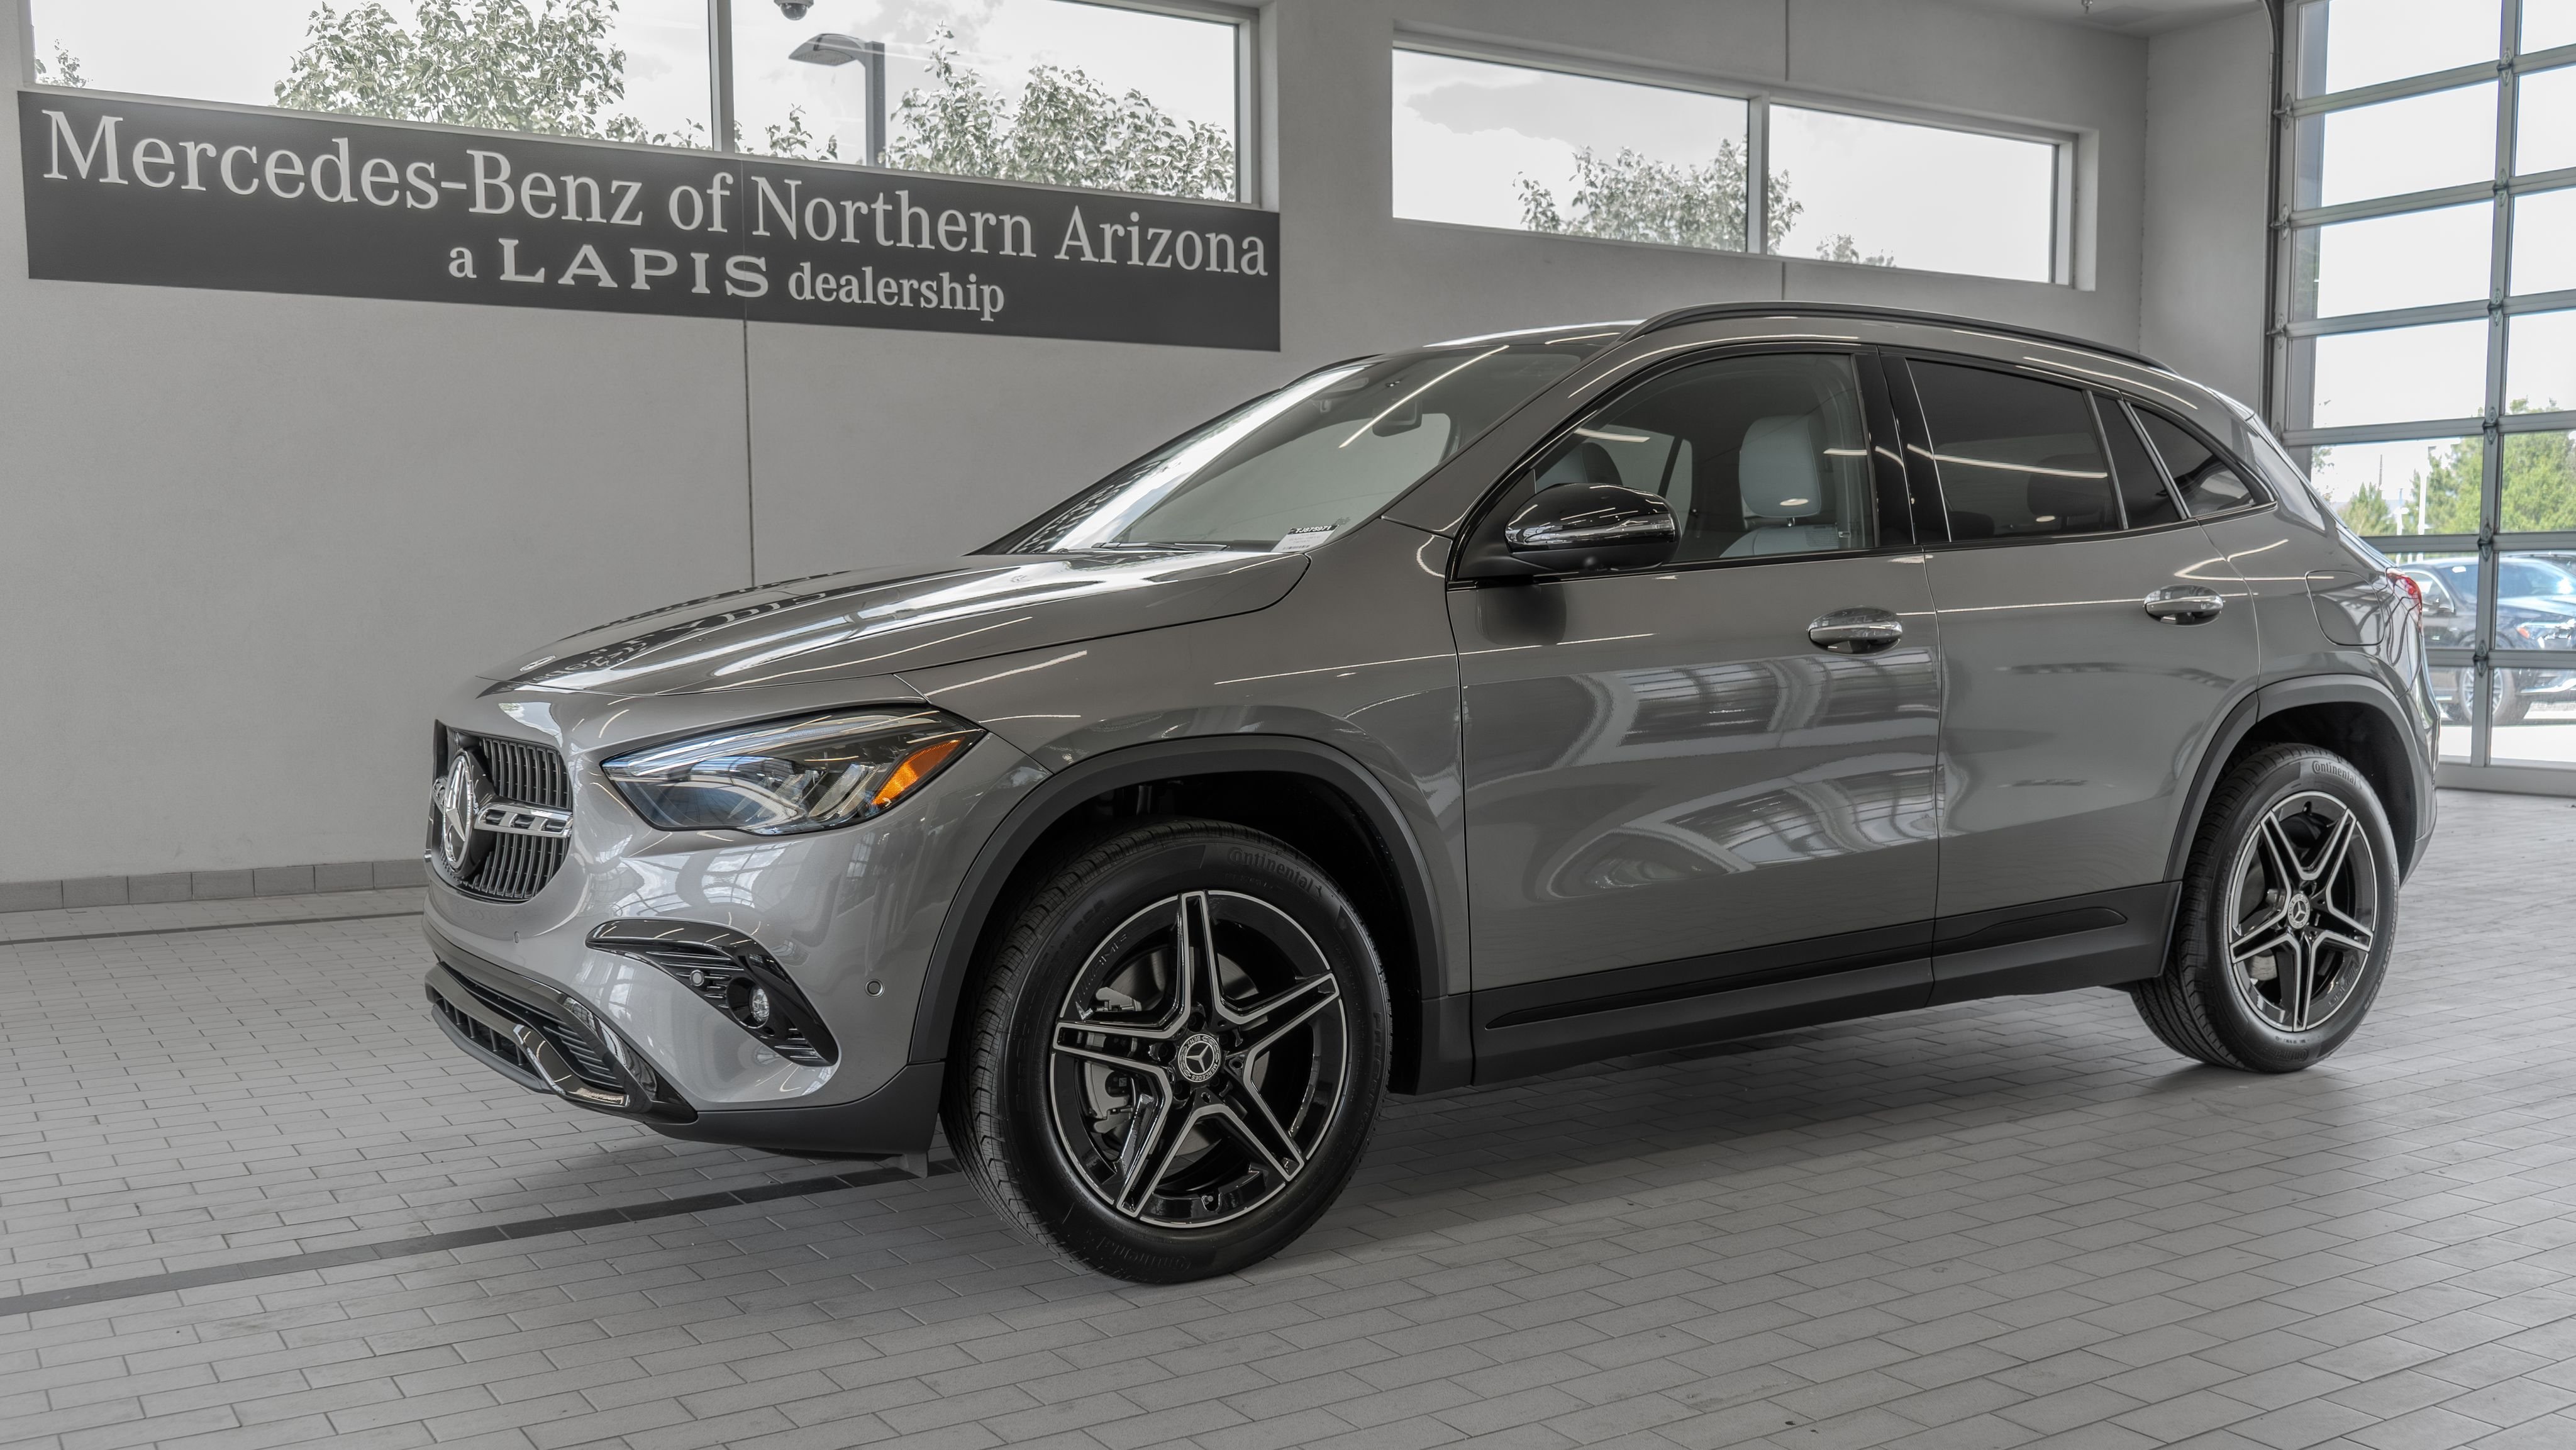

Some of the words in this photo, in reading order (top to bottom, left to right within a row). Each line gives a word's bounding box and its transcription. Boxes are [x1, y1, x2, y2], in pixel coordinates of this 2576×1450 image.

[42, 109, 643, 226] Mercedes-Benz
[668, 172, 733, 233] of
[751, 176, 1037, 258] Northern
[1054, 205, 1269, 276] Arizona
[448, 246, 477, 279] a
[498, 238, 769, 298] LAPIS
[788, 261, 1004, 322] dealership
[2312, 760, 2357, 786] Continental
[1226, 847, 1314, 893] Continental
[1186, 1035, 1201, 1047] BENZ
[1191, 1062, 1218, 1081] MERCEDES
